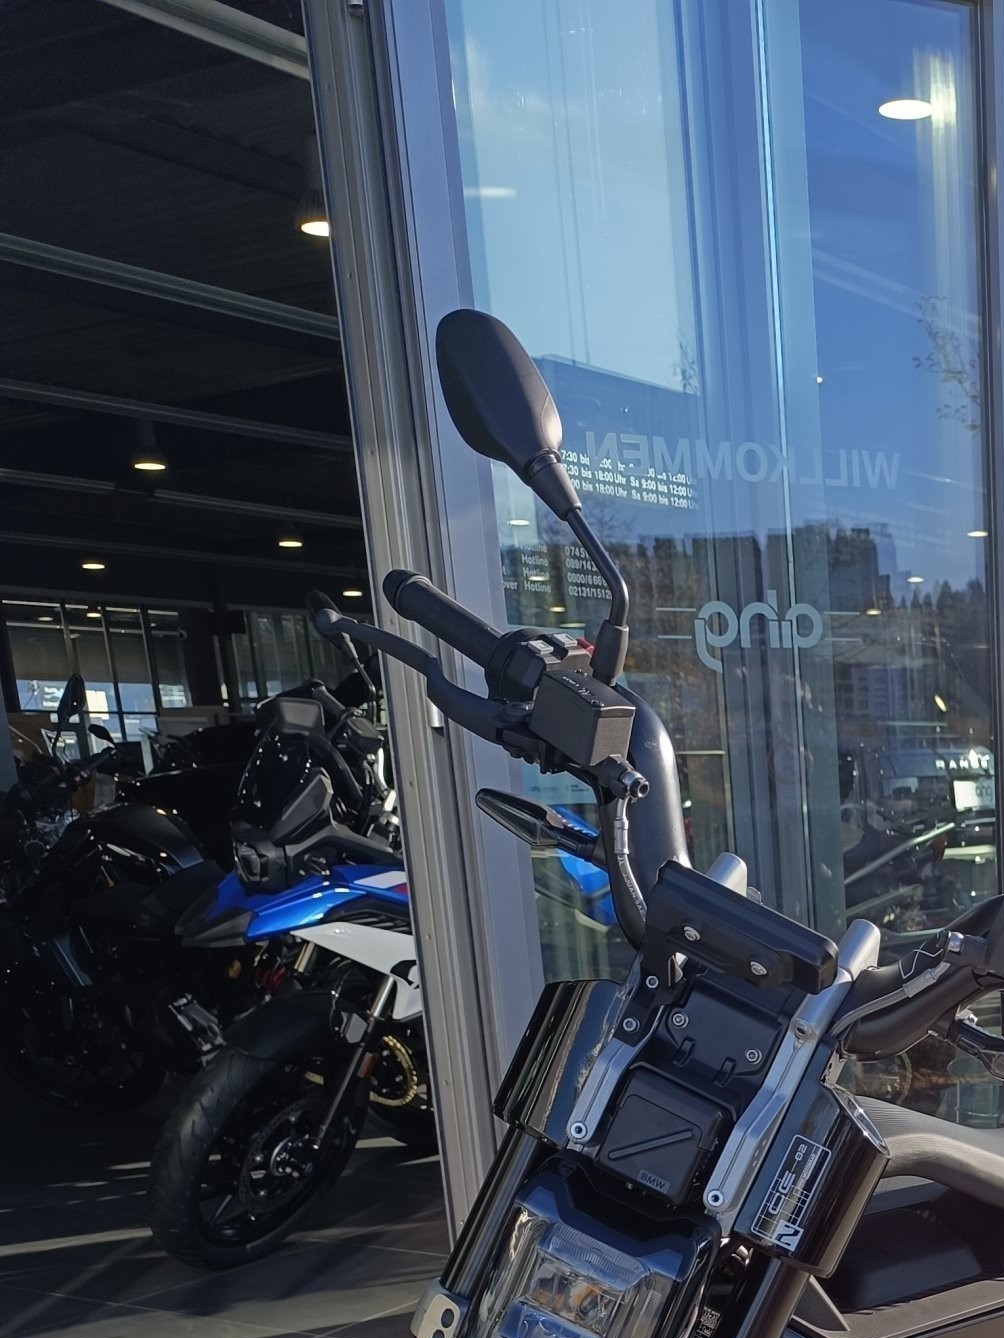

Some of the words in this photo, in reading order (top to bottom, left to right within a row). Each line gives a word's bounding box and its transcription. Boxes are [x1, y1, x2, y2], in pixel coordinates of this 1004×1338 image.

[581, 468, 592, 479] bis
[614, 474, 626, 485] Uhr
[630, 476, 640, 487] Sa
[642, 479, 656, 491] 9:00
[658, 481, 668, 493] bis
[670, 484, 686, 497] 12:00
[582, 481, 593, 493] bis
[615, 487, 627, 498] Uhr
[631, 489, 640, 501] Sa
[643, 491, 657, 504] 9:00
[659, 495, 669, 506] bis
[671, 497, 687, 509] 12:00
[521, 554, 549, 567] Hotline
[565, 560, 597, 573] 089/143
[524, 581, 552, 593] Hotline
[568, 585, 612, 600] 02131/1512
[640, 1172, 666, 1189] BMW
